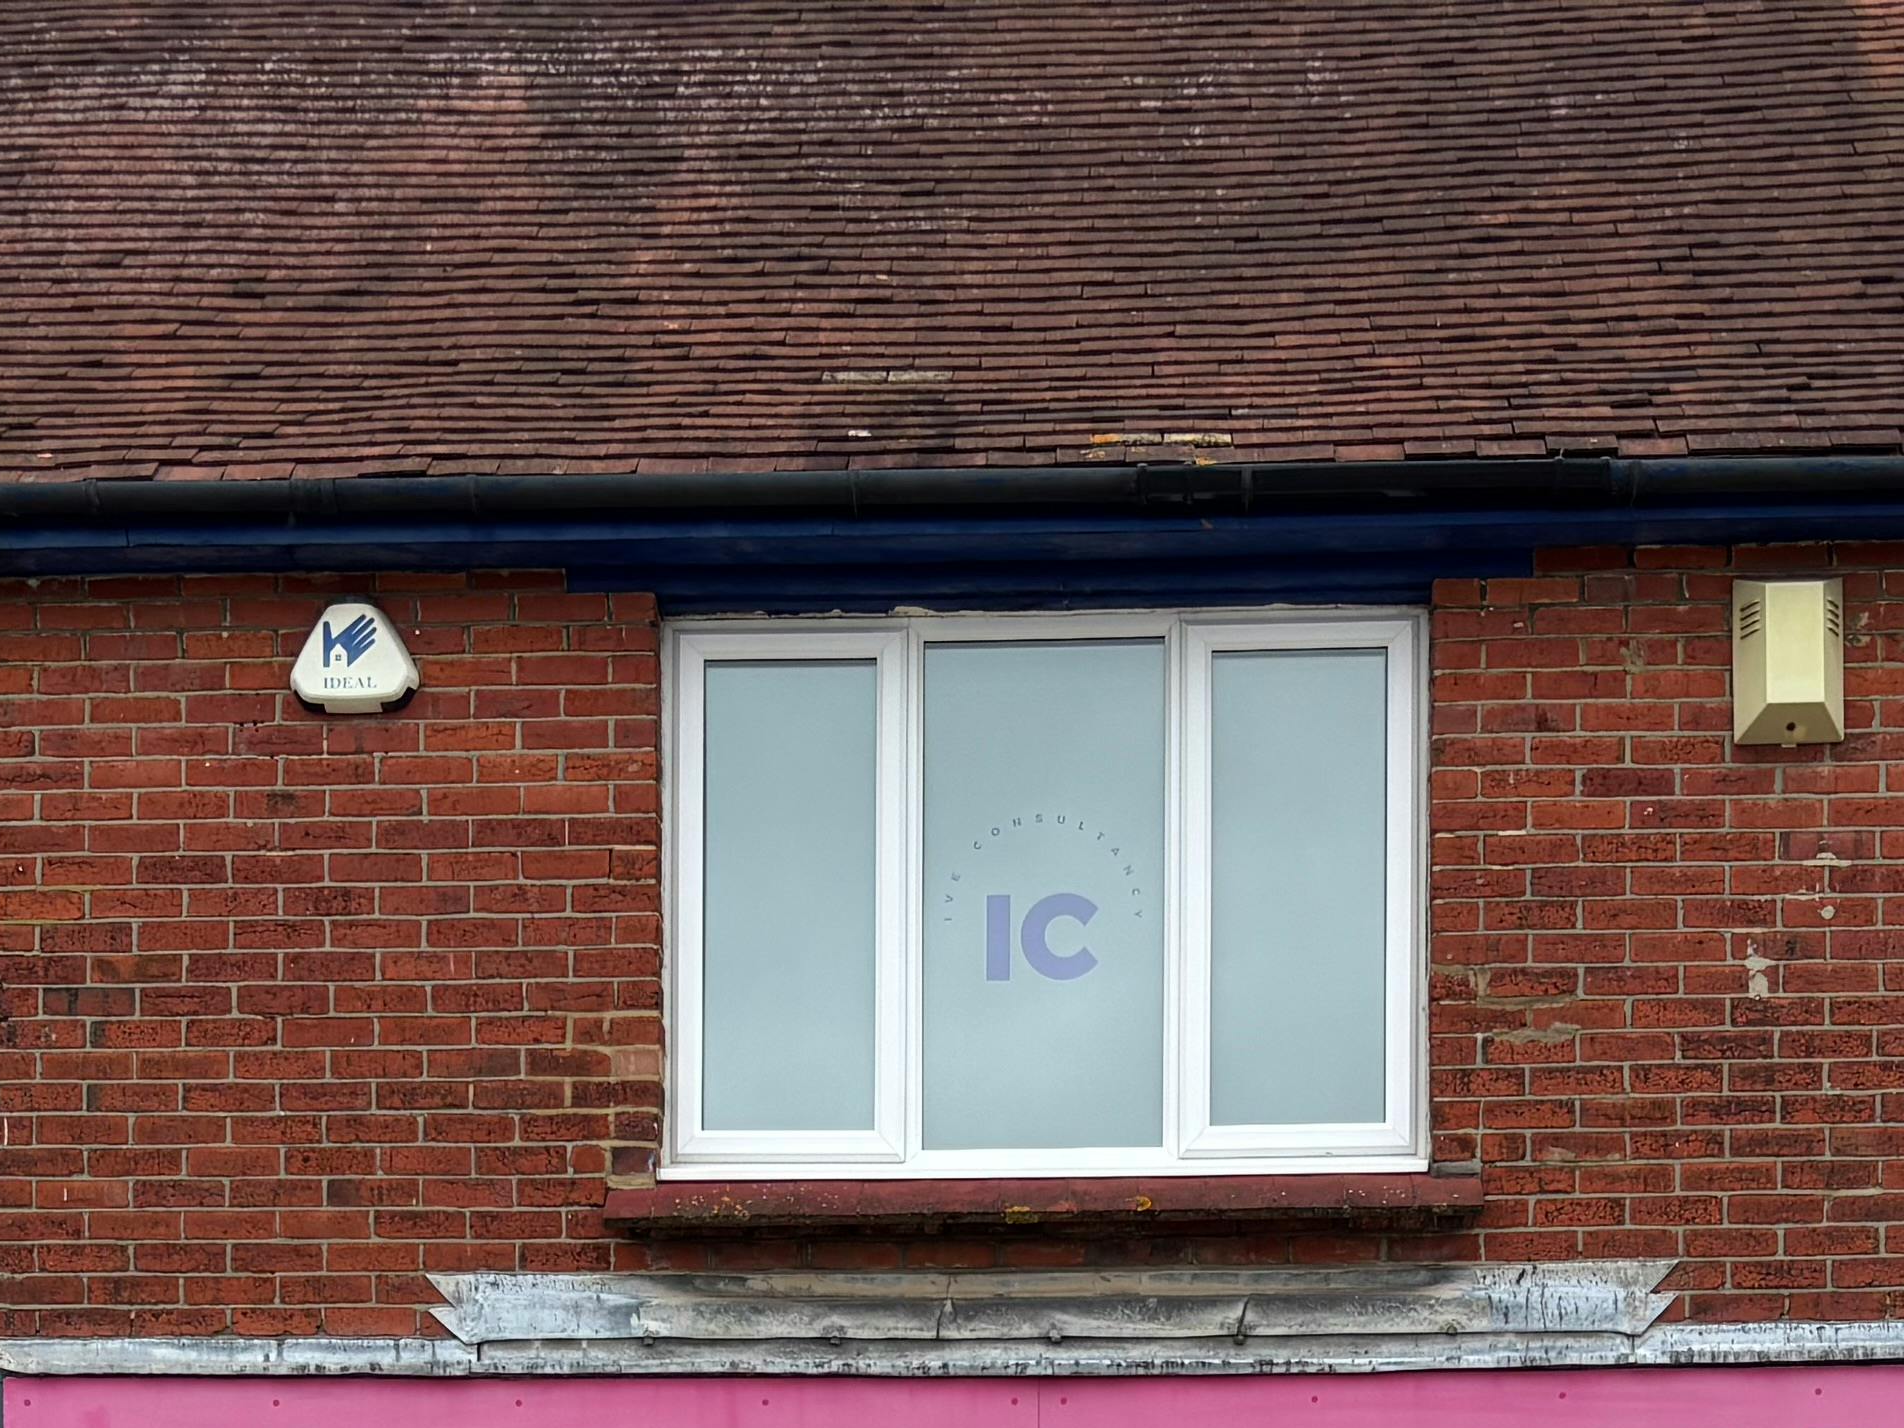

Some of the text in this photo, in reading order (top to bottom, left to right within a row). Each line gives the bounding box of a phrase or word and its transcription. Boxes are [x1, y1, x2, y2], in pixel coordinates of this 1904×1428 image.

[324, 677, 377, 689] IDEAL
[973, 814, 1143, 919] CONSULTANCY
[986, 893, 1098, 981] IC
